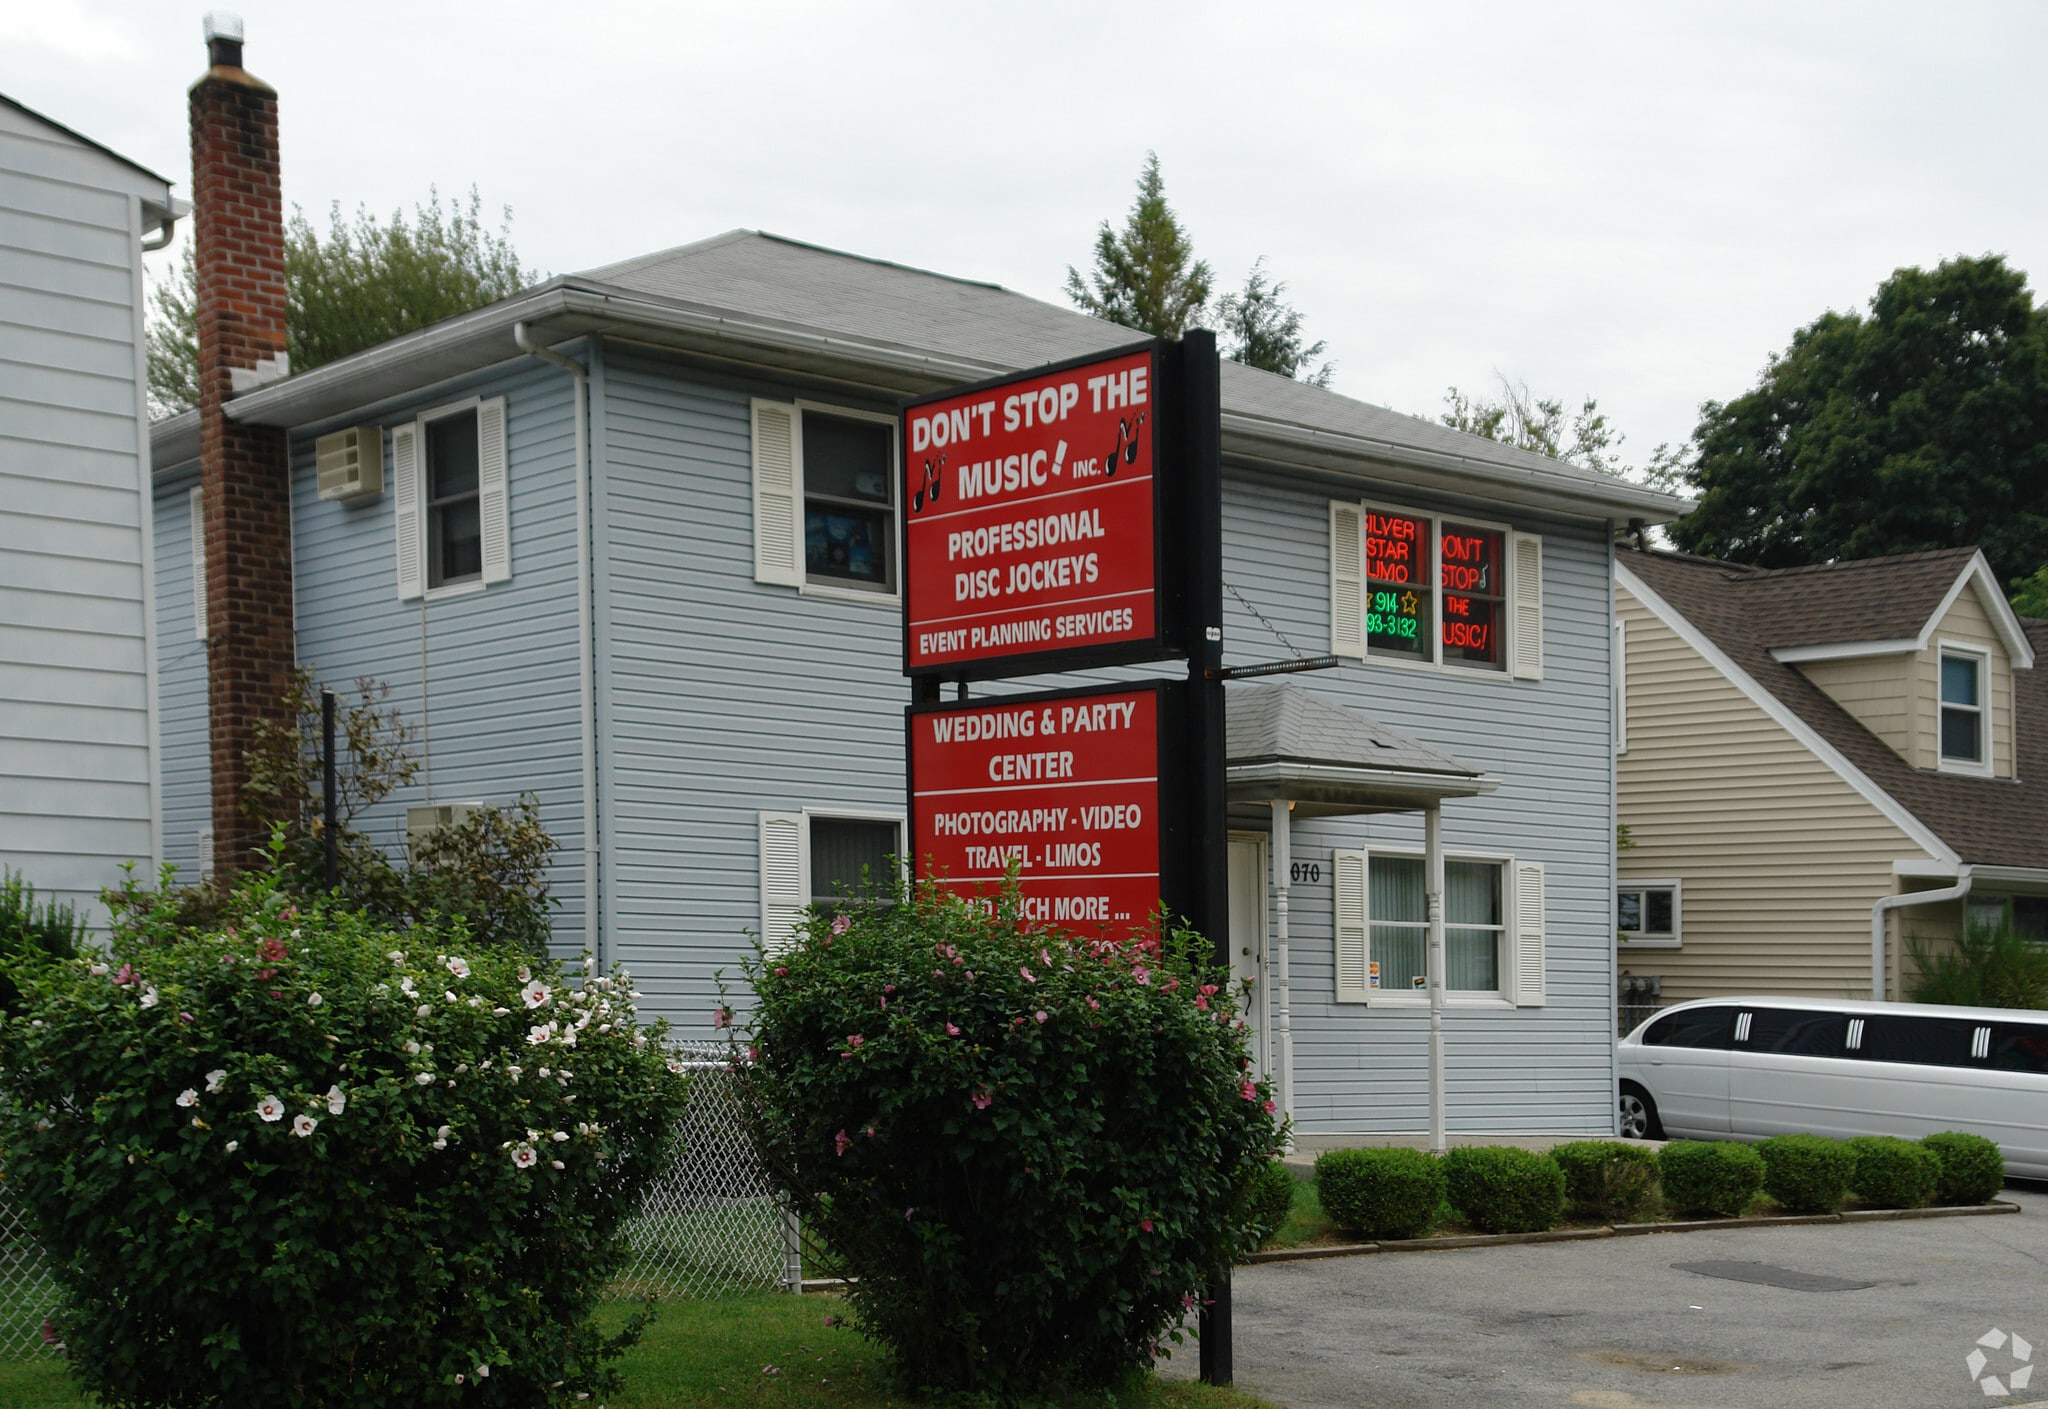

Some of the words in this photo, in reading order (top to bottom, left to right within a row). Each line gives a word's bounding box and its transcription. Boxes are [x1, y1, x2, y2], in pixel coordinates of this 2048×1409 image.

[913, 401, 995, 452] DON'T
[1004, 382, 1079, 432] STOP
[1088, 366, 1147, 414] THE
[958, 439, 1068, 500] MUSIC!
[1073, 458, 1101, 478] INC.
[948, 508, 1105, 561] PROFESSIONAL
[1366, 537, 1409, 561] STAR
[955, 568, 1000, 601] DISC
[1006, 553, 1099, 595] JOCKEYS
[1366, 558, 1409, 584] LIMO
[1375, 592, 1399, 613] 914
[1447, 596, 1470, 616] THE
[920, 628, 967, 655] EVENT
[971, 618, 1051, 649] PLANNING
[1055, 607, 1133, 639] SERVICES
[933, 710, 1035, 743] WEDDING
[1040, 708, 1056, 736] &
[1061, 701, 1136, 734] PARTY
[989, 751, 1074, 782] CENTER
[935, 808, 1069, 836] PHOTOGRAPHY
[1080, 804, 1142, 830] VIDEO
[965, 845, 1032, 869] TRAVEL
[1045, 842, 1101, 868] LIMOS
[1290, 862, 1320, 883] 070
[997, 897, 1049, 920] UCH
